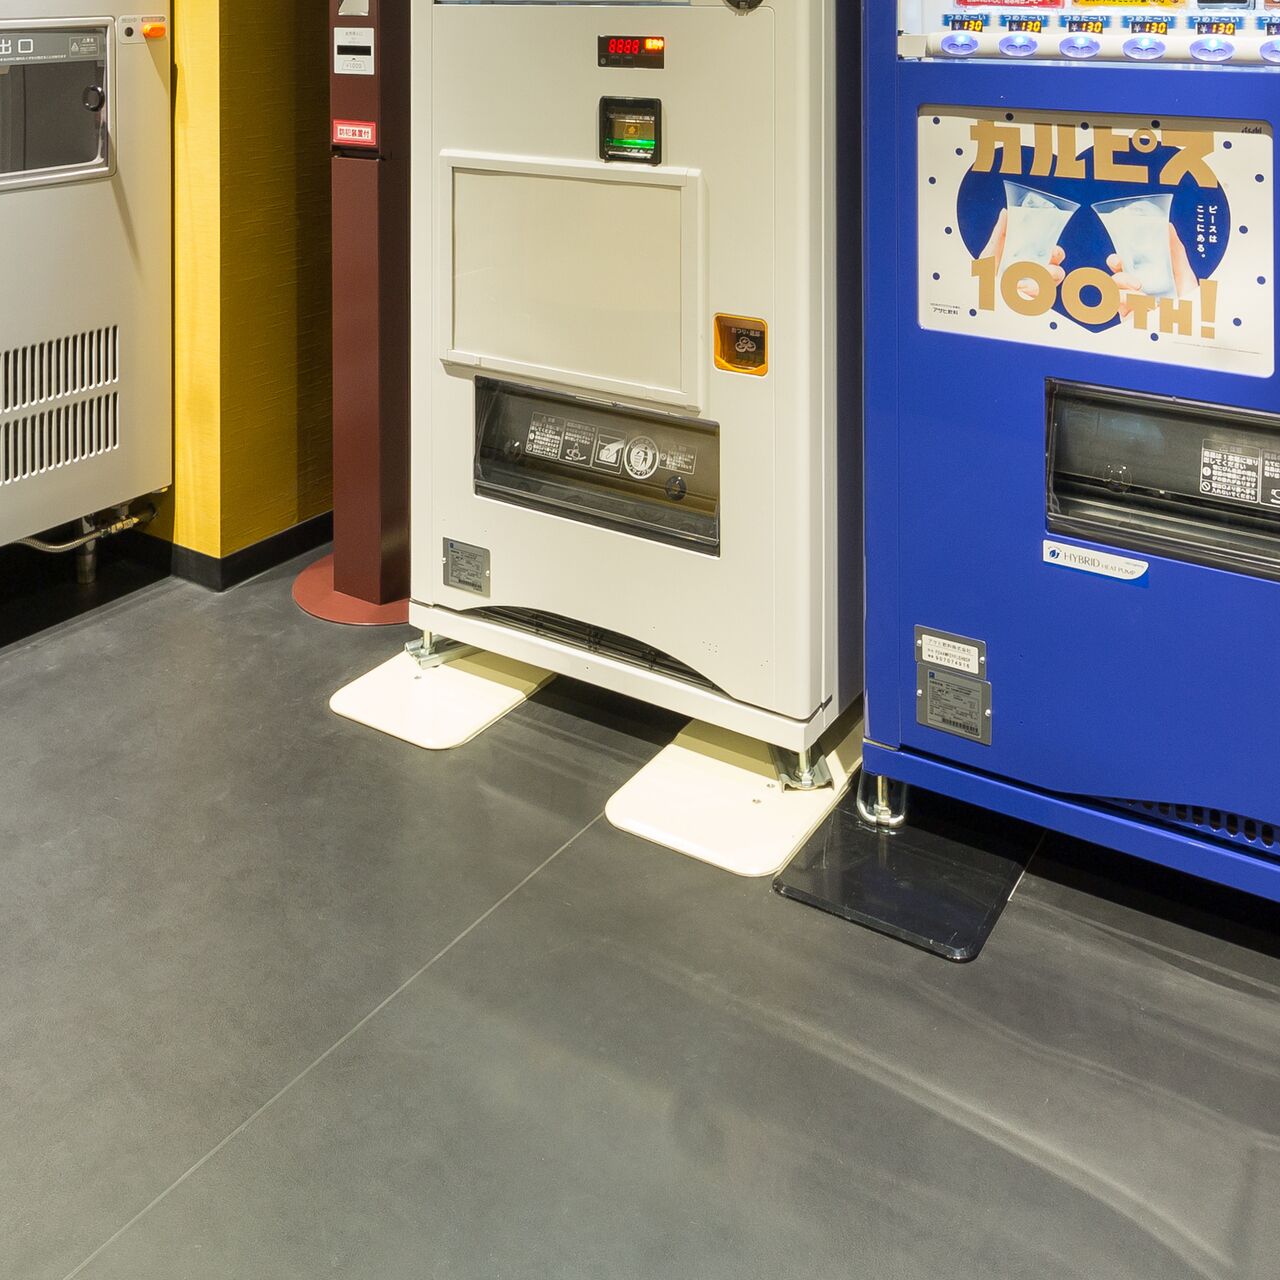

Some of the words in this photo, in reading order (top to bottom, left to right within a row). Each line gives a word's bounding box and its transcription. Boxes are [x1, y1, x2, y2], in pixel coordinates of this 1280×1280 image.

[970, 119, 1219, 189] カルピス
[1195, 204, 1207, 259] ここにある。
[1207, 204, 1218, 244] ピースは
[1064, 552, 1100, 567] HYBRID
